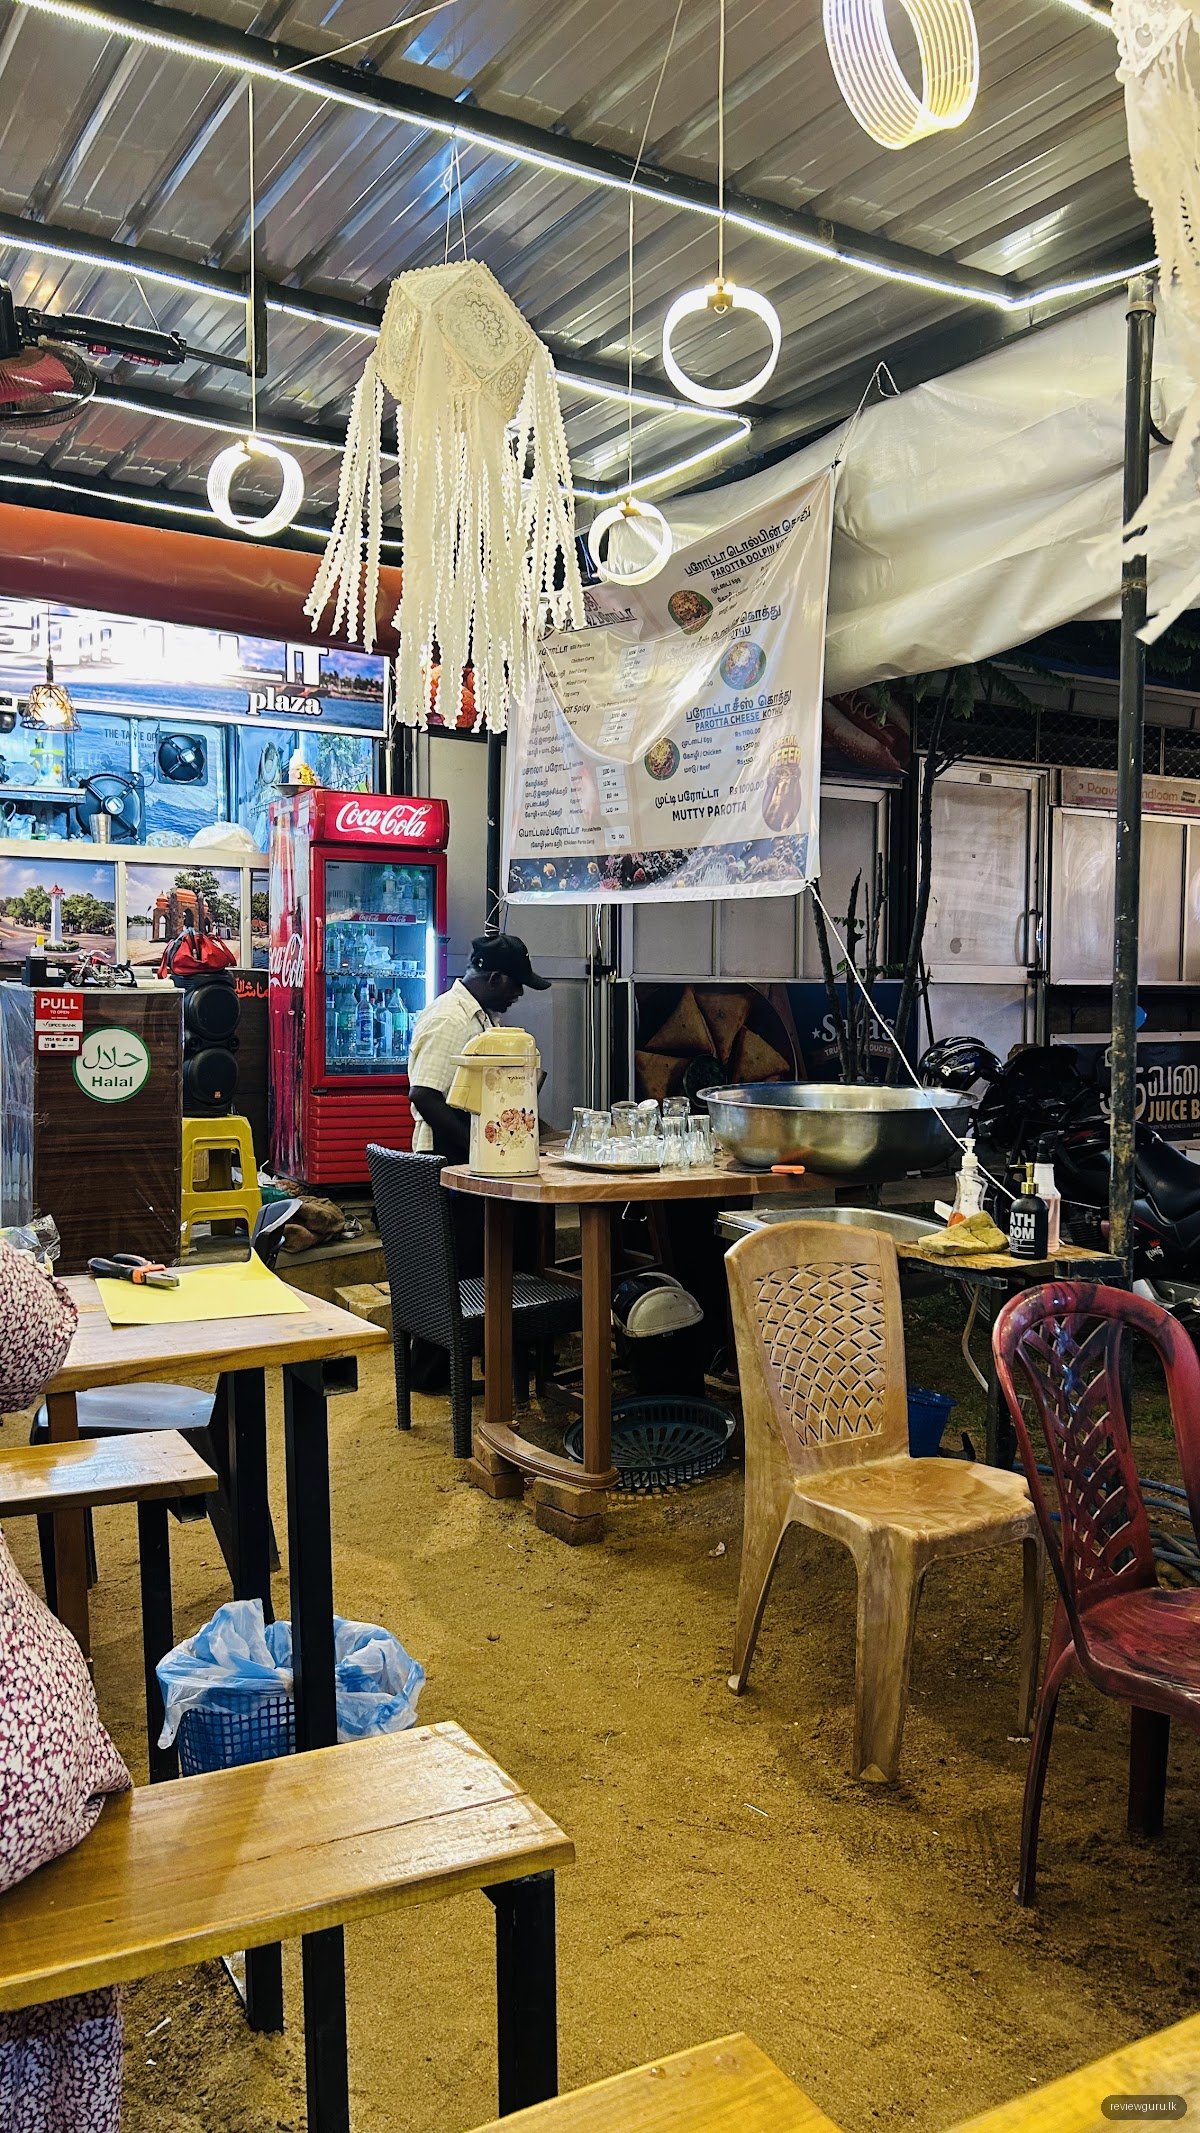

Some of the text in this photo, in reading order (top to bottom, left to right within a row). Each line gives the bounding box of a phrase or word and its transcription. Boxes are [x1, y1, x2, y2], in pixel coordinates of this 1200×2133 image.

[684, 553, 726, 576] பரோட்டா
[711, 557, 746, 579] PAROTTA
[745, 543, 775, 562] DOLPIN
[248, 686, 322, 716] plaza
[685, 689, 792, 720] பரோட்டா சீஸ் கொத்து
[695, 705, 784, 731] PAROTTA CHEESE KOTHU
[104, 728, 119, 739] THE
[655, 792, 676, 808] முட்டி
[678, 784, 720, 804] பரோட்டா
[336, 800, 433, 837] Coca-Cola
[672, 801, 747, 821] MUTTY PAROTTA
[40, 997, 79, 1010] PULL
[83, 1045, 143, 1070] حلال
[92, 1076, 133, 1087] Halal
[1147, 1099, 1188, 1122] JUICE
[1010, 1212, 1036, 1228] ATH
